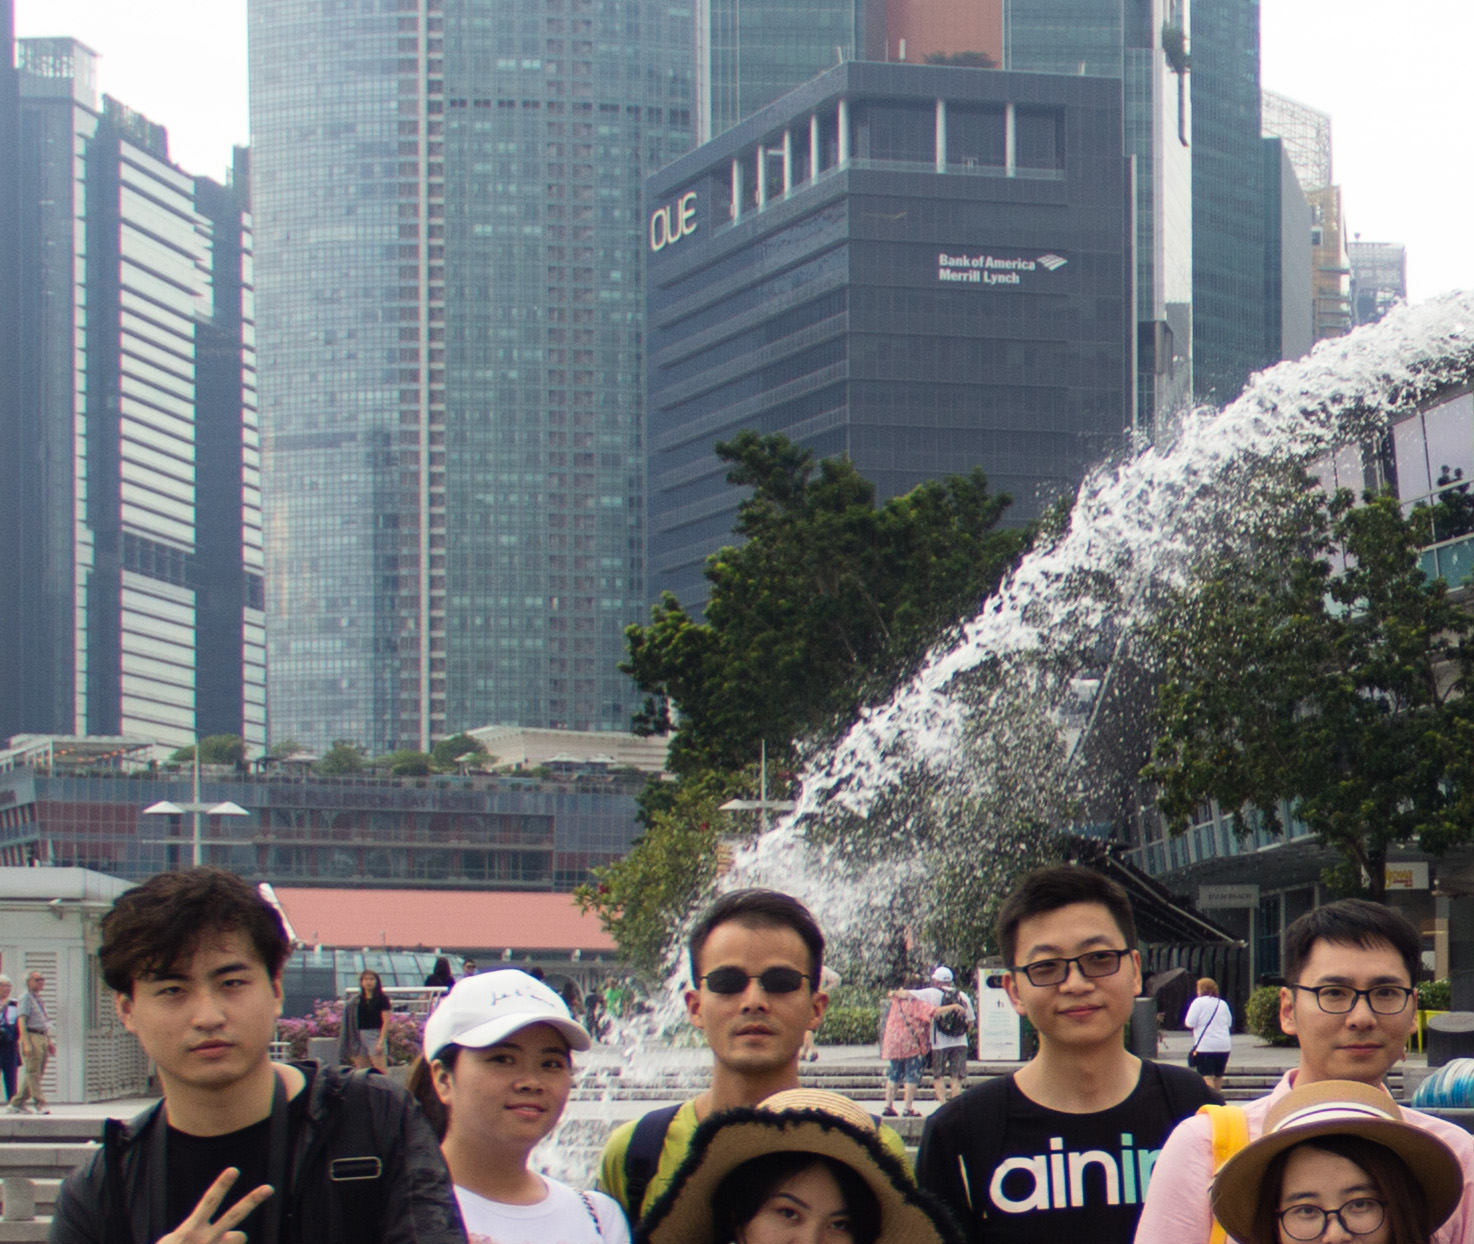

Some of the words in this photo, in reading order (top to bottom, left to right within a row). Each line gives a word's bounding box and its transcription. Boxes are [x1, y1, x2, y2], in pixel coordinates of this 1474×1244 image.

[650, 191, 698, 252] OUE
[939, 253, 971, 267] Bank
[971, 256, 985, 268] of
[985, 256, 1036, 271] America
[939, 268, 981, 283] Merrill
[983, 270, 1021, 285] Lynch
